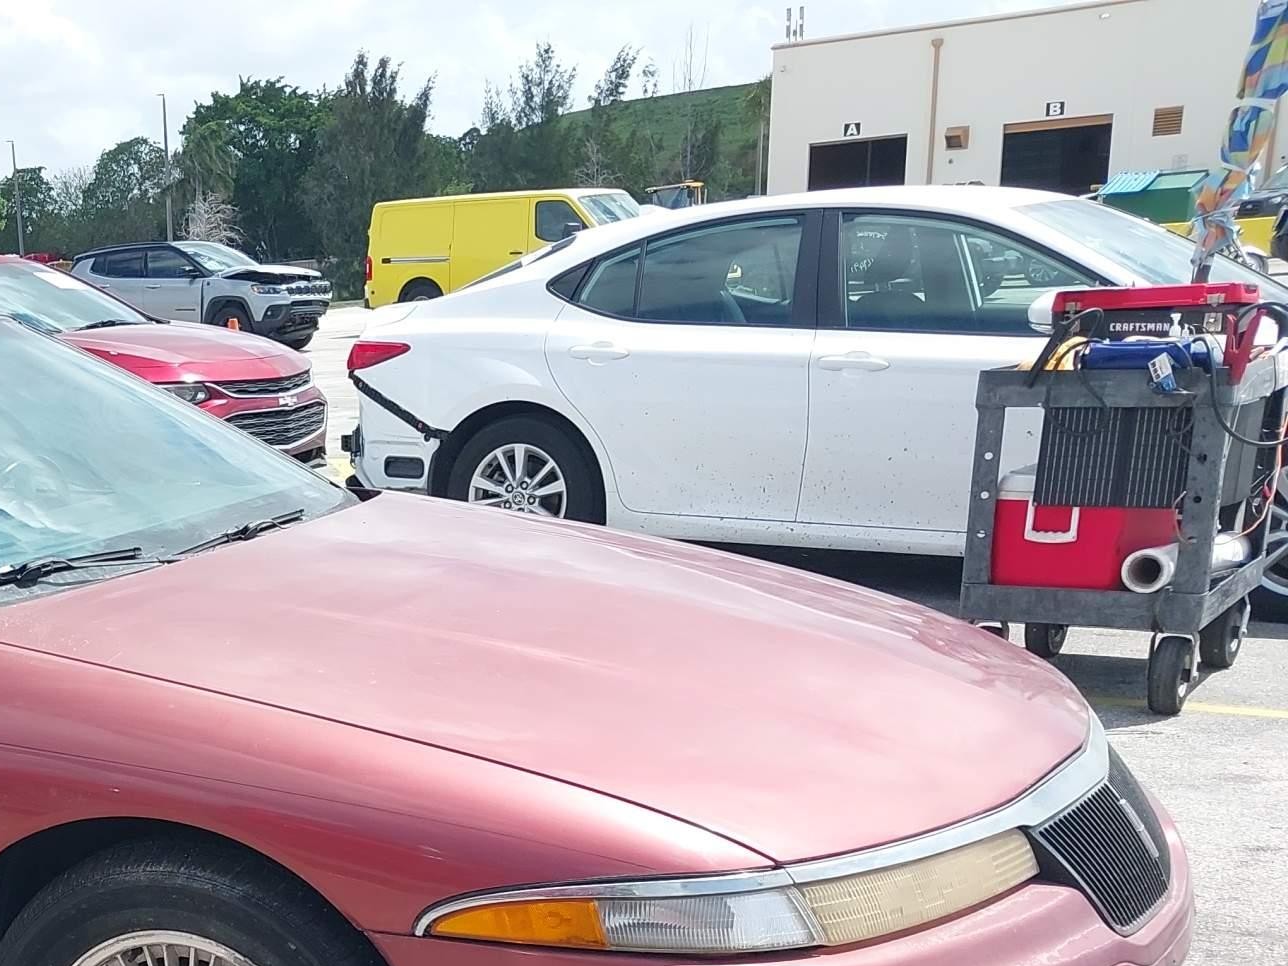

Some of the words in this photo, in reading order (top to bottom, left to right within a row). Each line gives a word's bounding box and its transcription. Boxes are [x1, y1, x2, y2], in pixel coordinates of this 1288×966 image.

[1049, 103, 1062, 116] B
[845, 123, 858, 136] A
[1109, 322, 1171, 332] CRAFTSMAN
